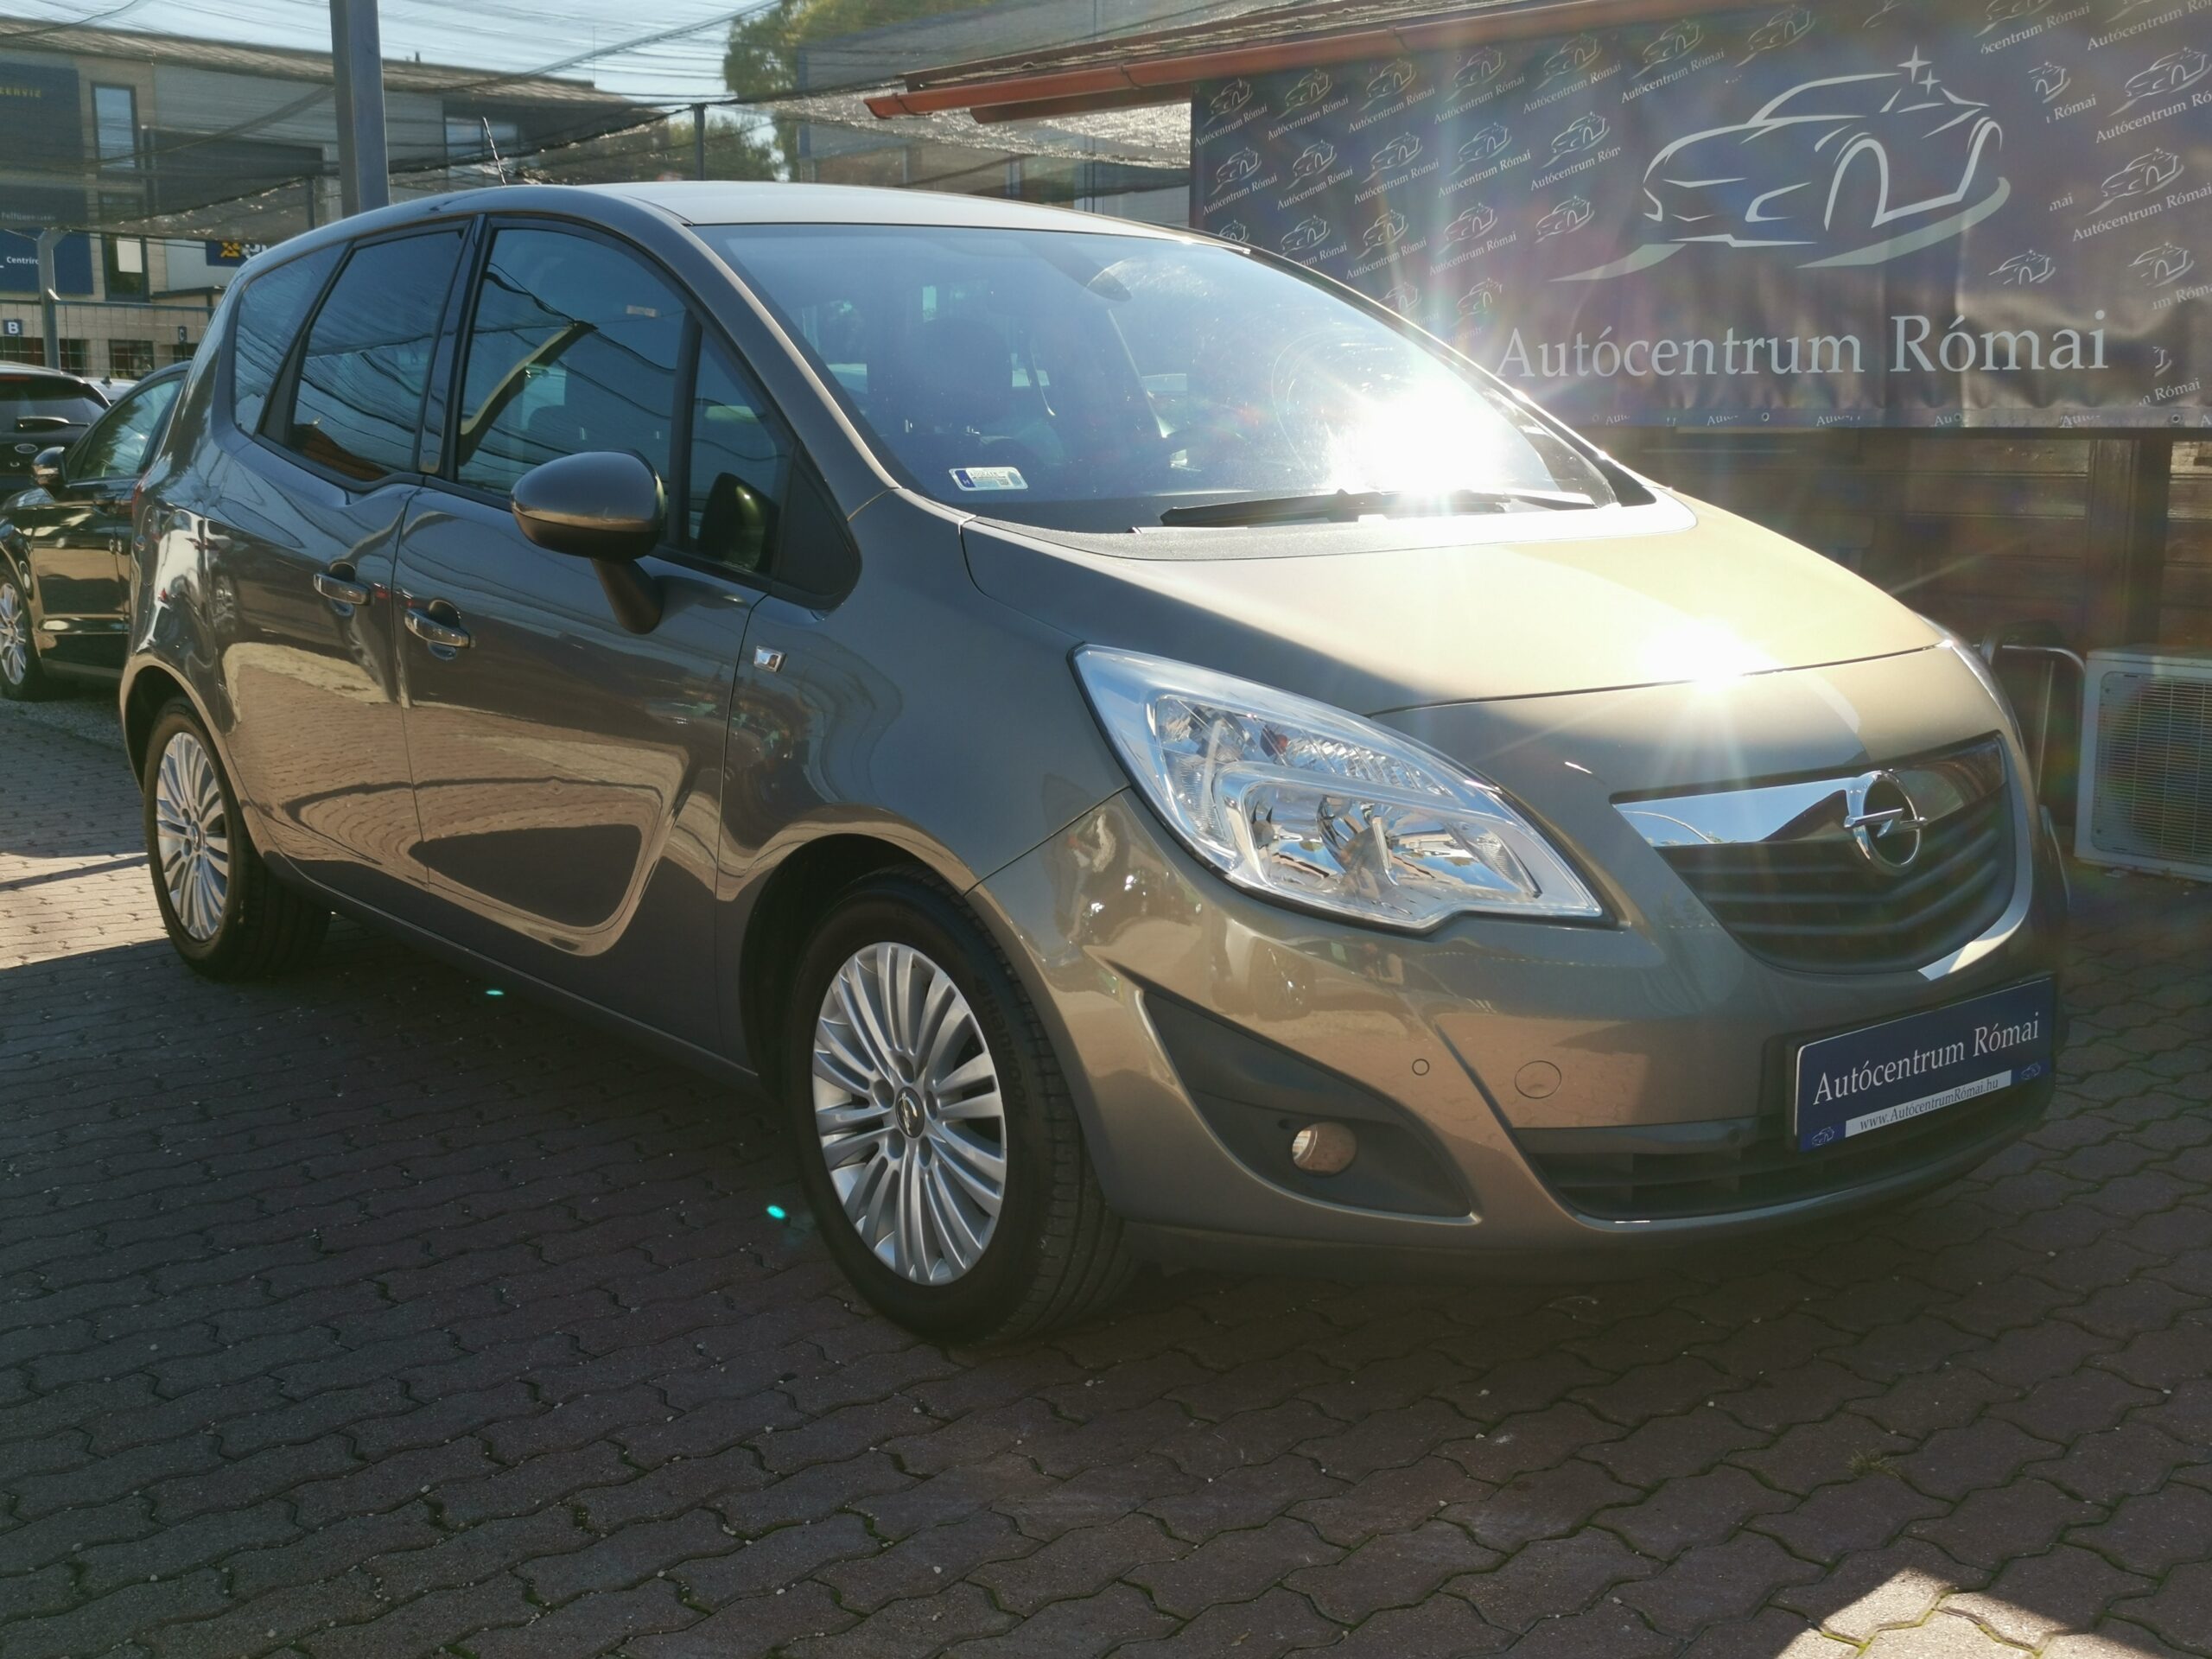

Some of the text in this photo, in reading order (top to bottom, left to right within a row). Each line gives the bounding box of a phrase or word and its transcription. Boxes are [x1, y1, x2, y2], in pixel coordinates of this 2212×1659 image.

[2045, 3, 2091, 29] Római
[2088, 8, 2183, 50] Autócentrum
[1433, 73, 1525, 124] Autócentrum Római
[1523, 60, 1622, 114] Autócentrum Római
[1620, 48, 1725, 104] Autócentrum Római
[1194, 103, 1268, 148] Autócentrum Római
[1268, 93, 1349, 141] Autócentrum Római
[1348, 84, 1435, 133] Autócentrum Római
[2053, 93, 2097, 121] Római
[2095, 100, 2187, 143] Autócentrum
[1203, 172, 1278, 216] Autócentrum Római
[1277, 165, 1354, 211] Autócentrum Római
[1354, 157, 1440, 205] Autócentrum Római
[1438, 148, 1532, 198] Autócentrum Római
[1530, 157, 1596, 192] Autócentrum
[2073, 181, 2212, 243] Autócentrum Római
[1319, 241, 1347, 261] Római
[1346, 236, 1427, 280] Autócentrum Római
[1429, 230, 1516, 277] Autócentrum Római
[8, 321, 18, 334] B
[1495, 309, 2109, 378] Autócentrum Római
[2155, 378, 2201, 401] Római
[1813, 1011, 2039, 1106] Autócentrum Római
[1859, 1077, 1999, 1131] www.AutócentrumRómai.hu
